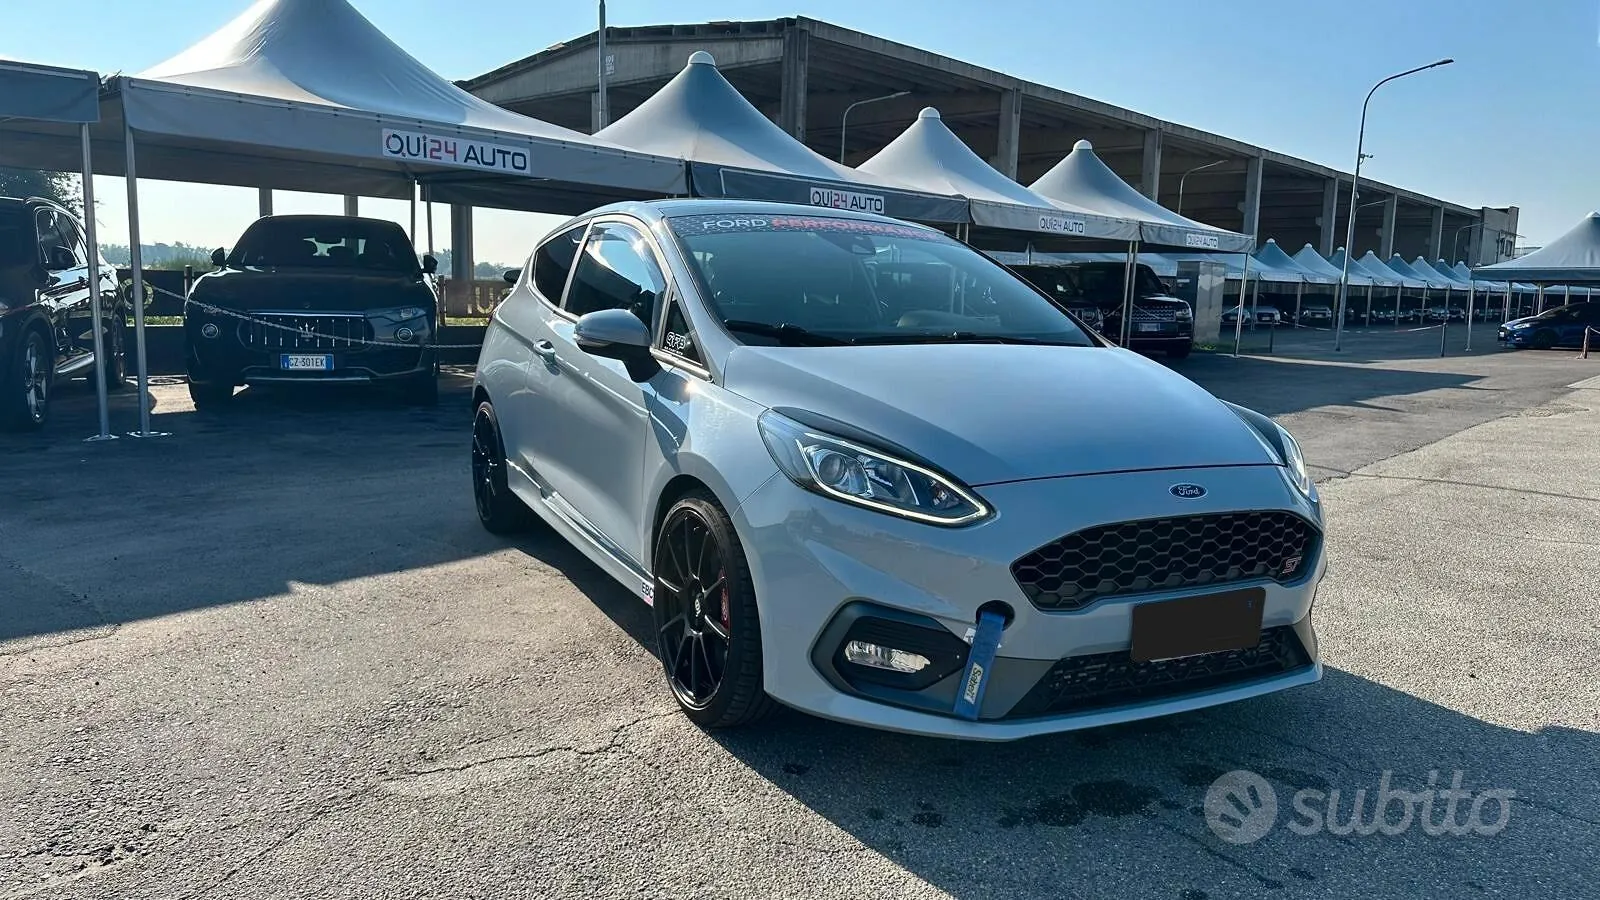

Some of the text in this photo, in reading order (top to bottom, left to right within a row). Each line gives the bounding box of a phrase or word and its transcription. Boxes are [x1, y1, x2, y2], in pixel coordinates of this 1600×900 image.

[463, 144, 527, 171] AUTO
[850, 195, 883, 211] AUTO
[702, 219, 767, 229] FORD
[1063, 220, 1084, 233] AUTO
[1177, 485, 1201, 496] Ford
